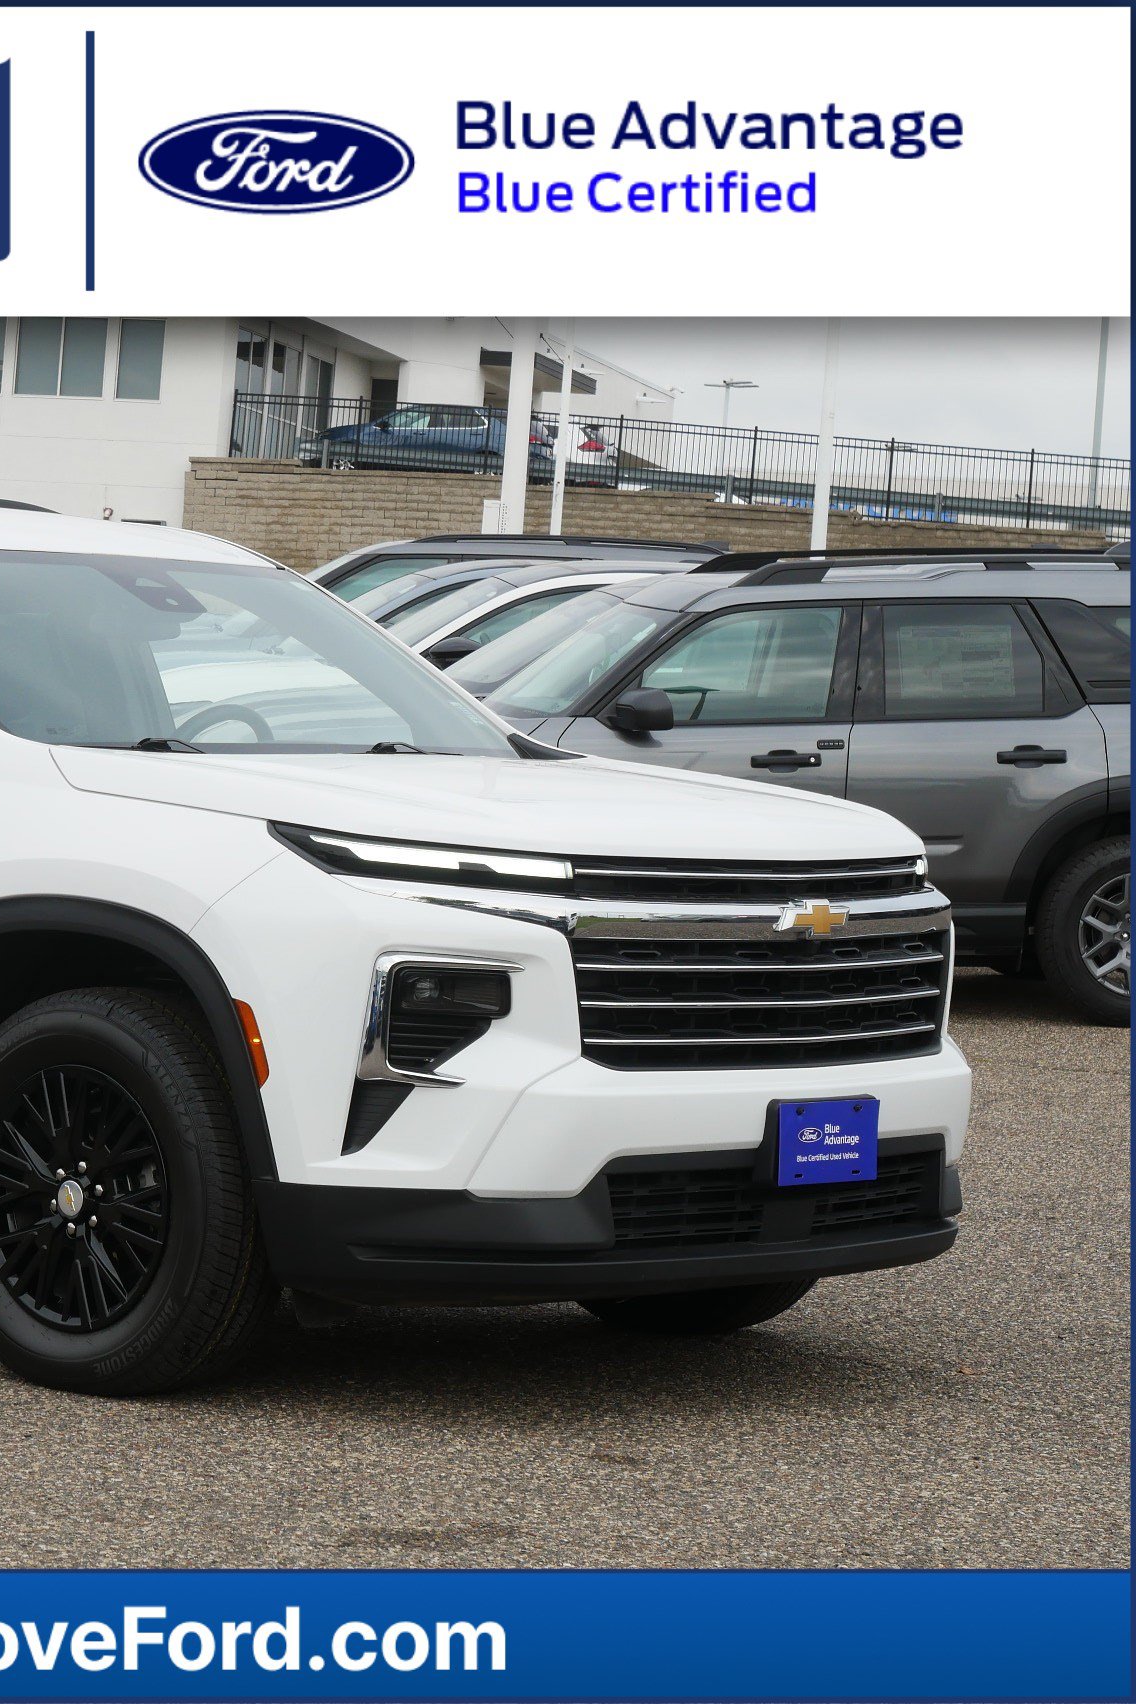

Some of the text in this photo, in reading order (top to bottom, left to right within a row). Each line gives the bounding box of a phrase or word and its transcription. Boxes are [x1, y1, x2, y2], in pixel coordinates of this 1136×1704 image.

[824, 1124, 840, 1134] Blue
[824, 1135, 860, 1146] Advantage
[808, 1153, 829, 1162] Certified
[842, 1152, 860, 1160] Vehicle
